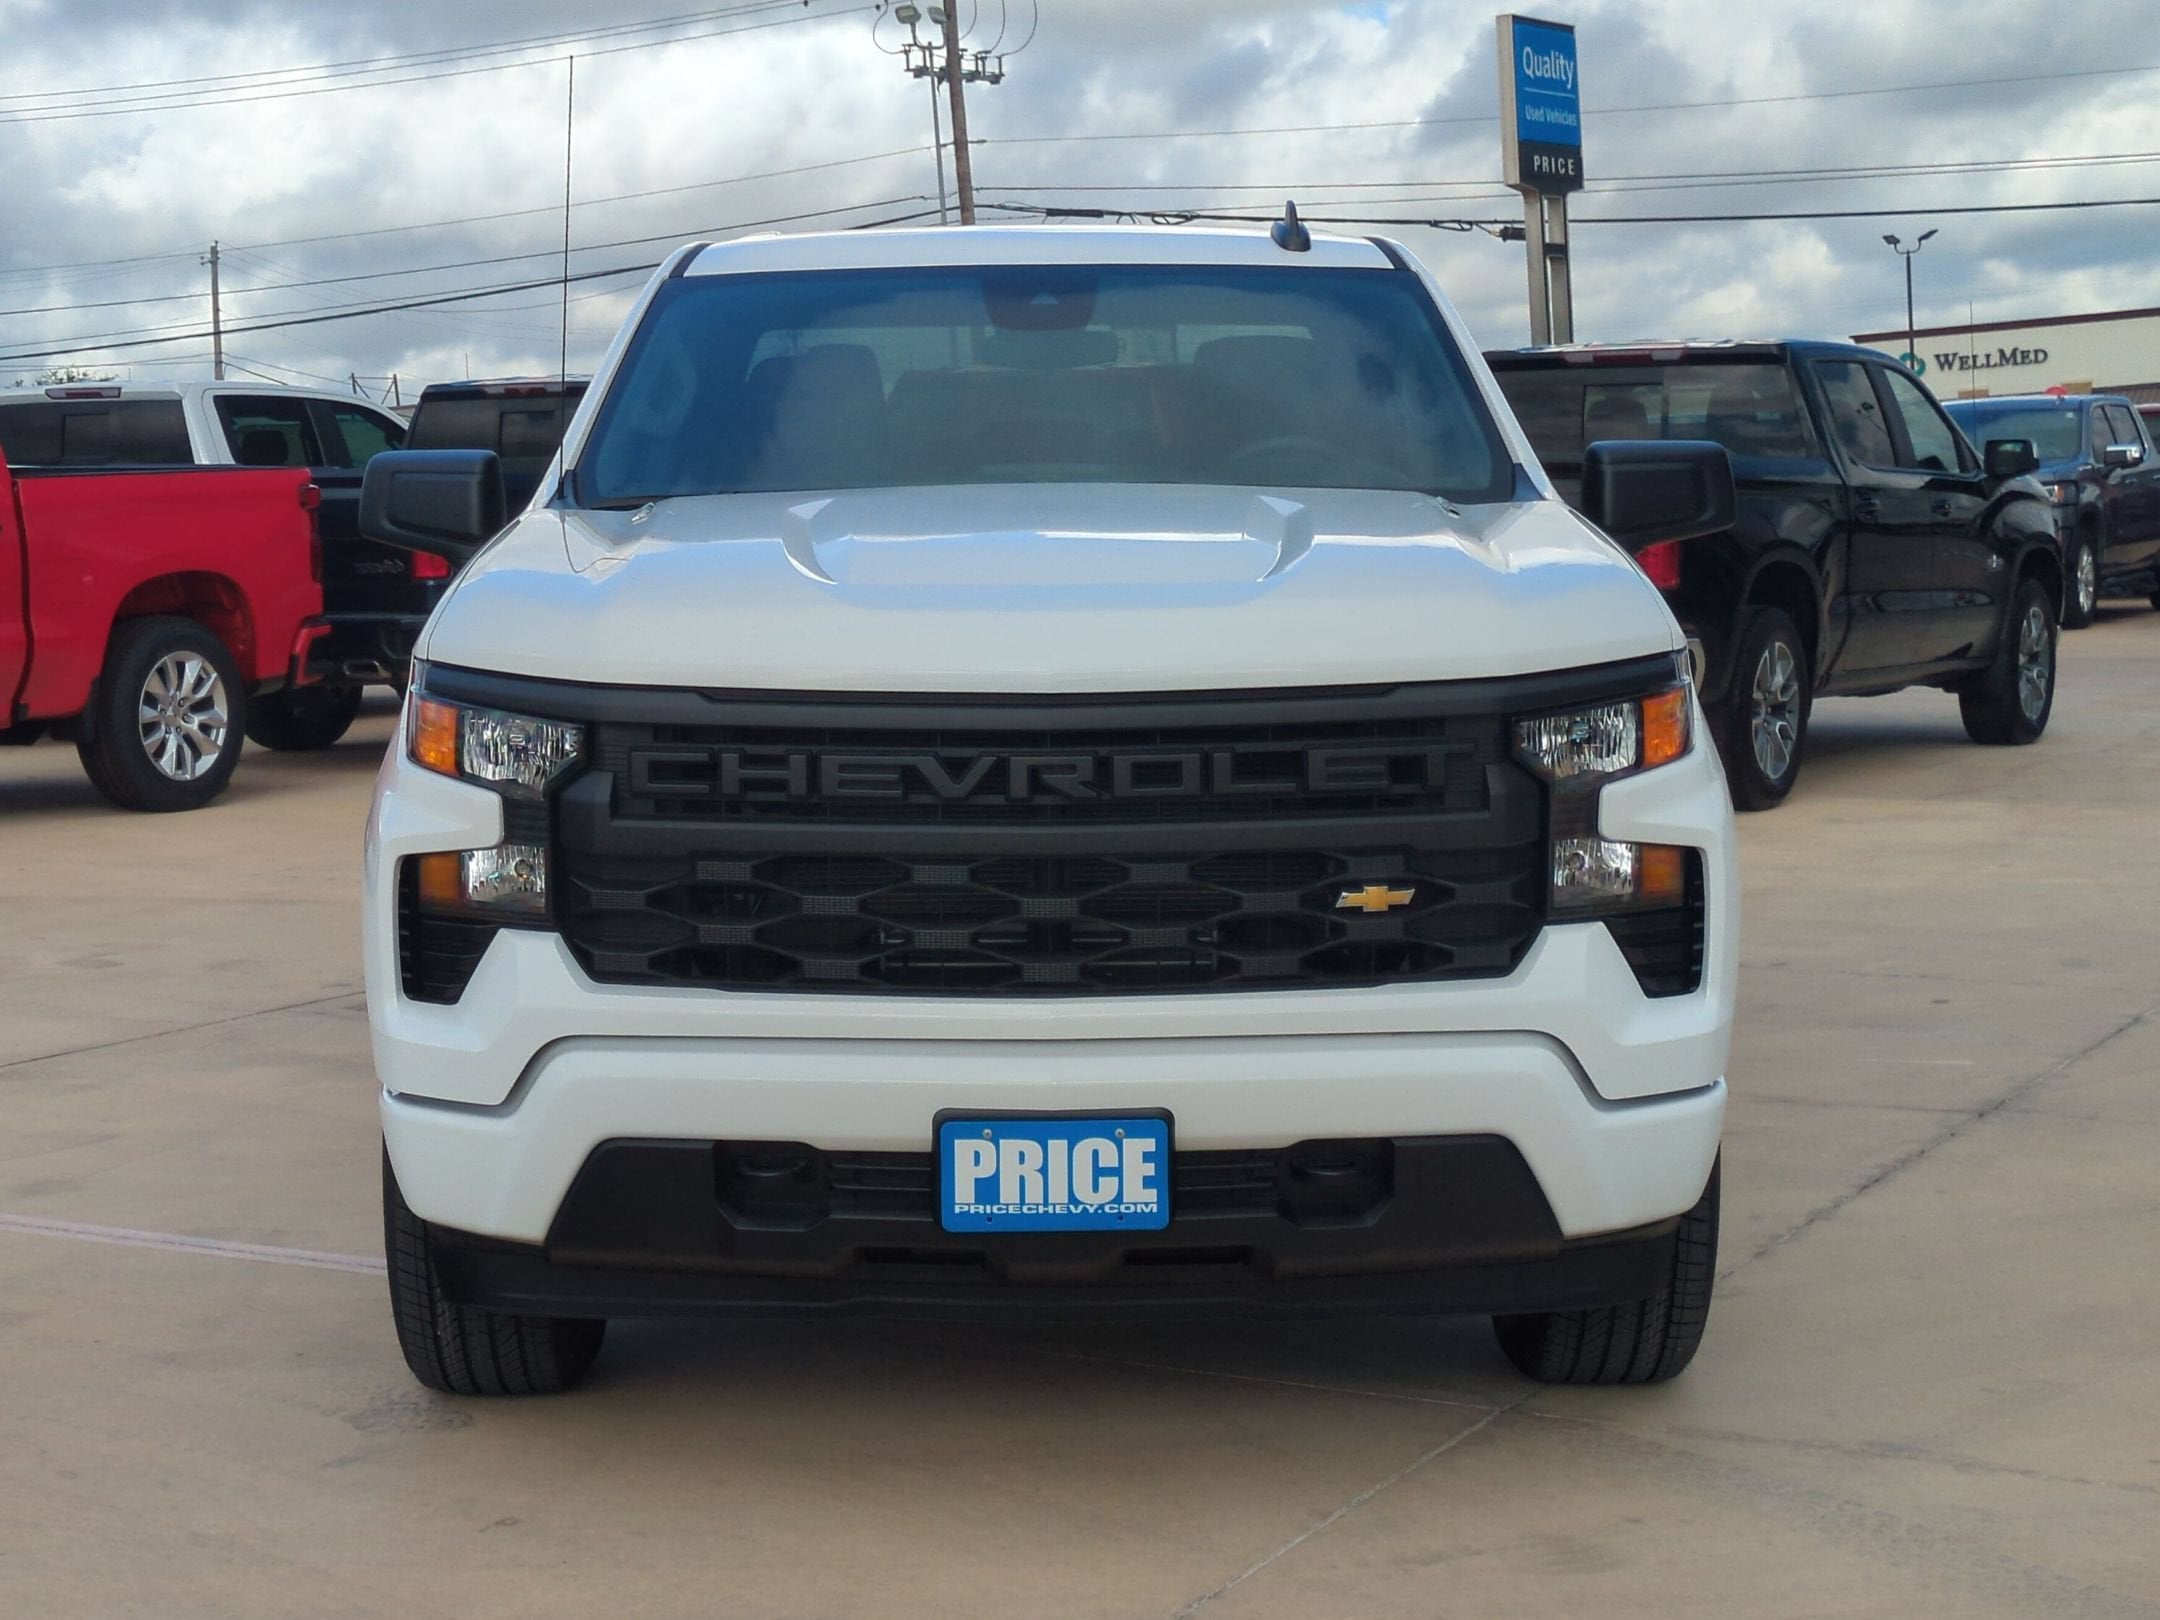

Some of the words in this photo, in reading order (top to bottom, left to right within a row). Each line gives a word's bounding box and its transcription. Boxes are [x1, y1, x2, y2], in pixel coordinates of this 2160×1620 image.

[1522, 46, 1575, 90] Quality
[1525, 104, 1545, 123] Used
[1546, 108, 1577, 127] Vehicles
[1533, 155, 1575, 176] PRICE
[630, 743, 1476, 800] CHEVROLET
[954, 1137, 1158, 1205] PRICE
[954, 1203, 1158, 1214] PRICECHEVY.COM
